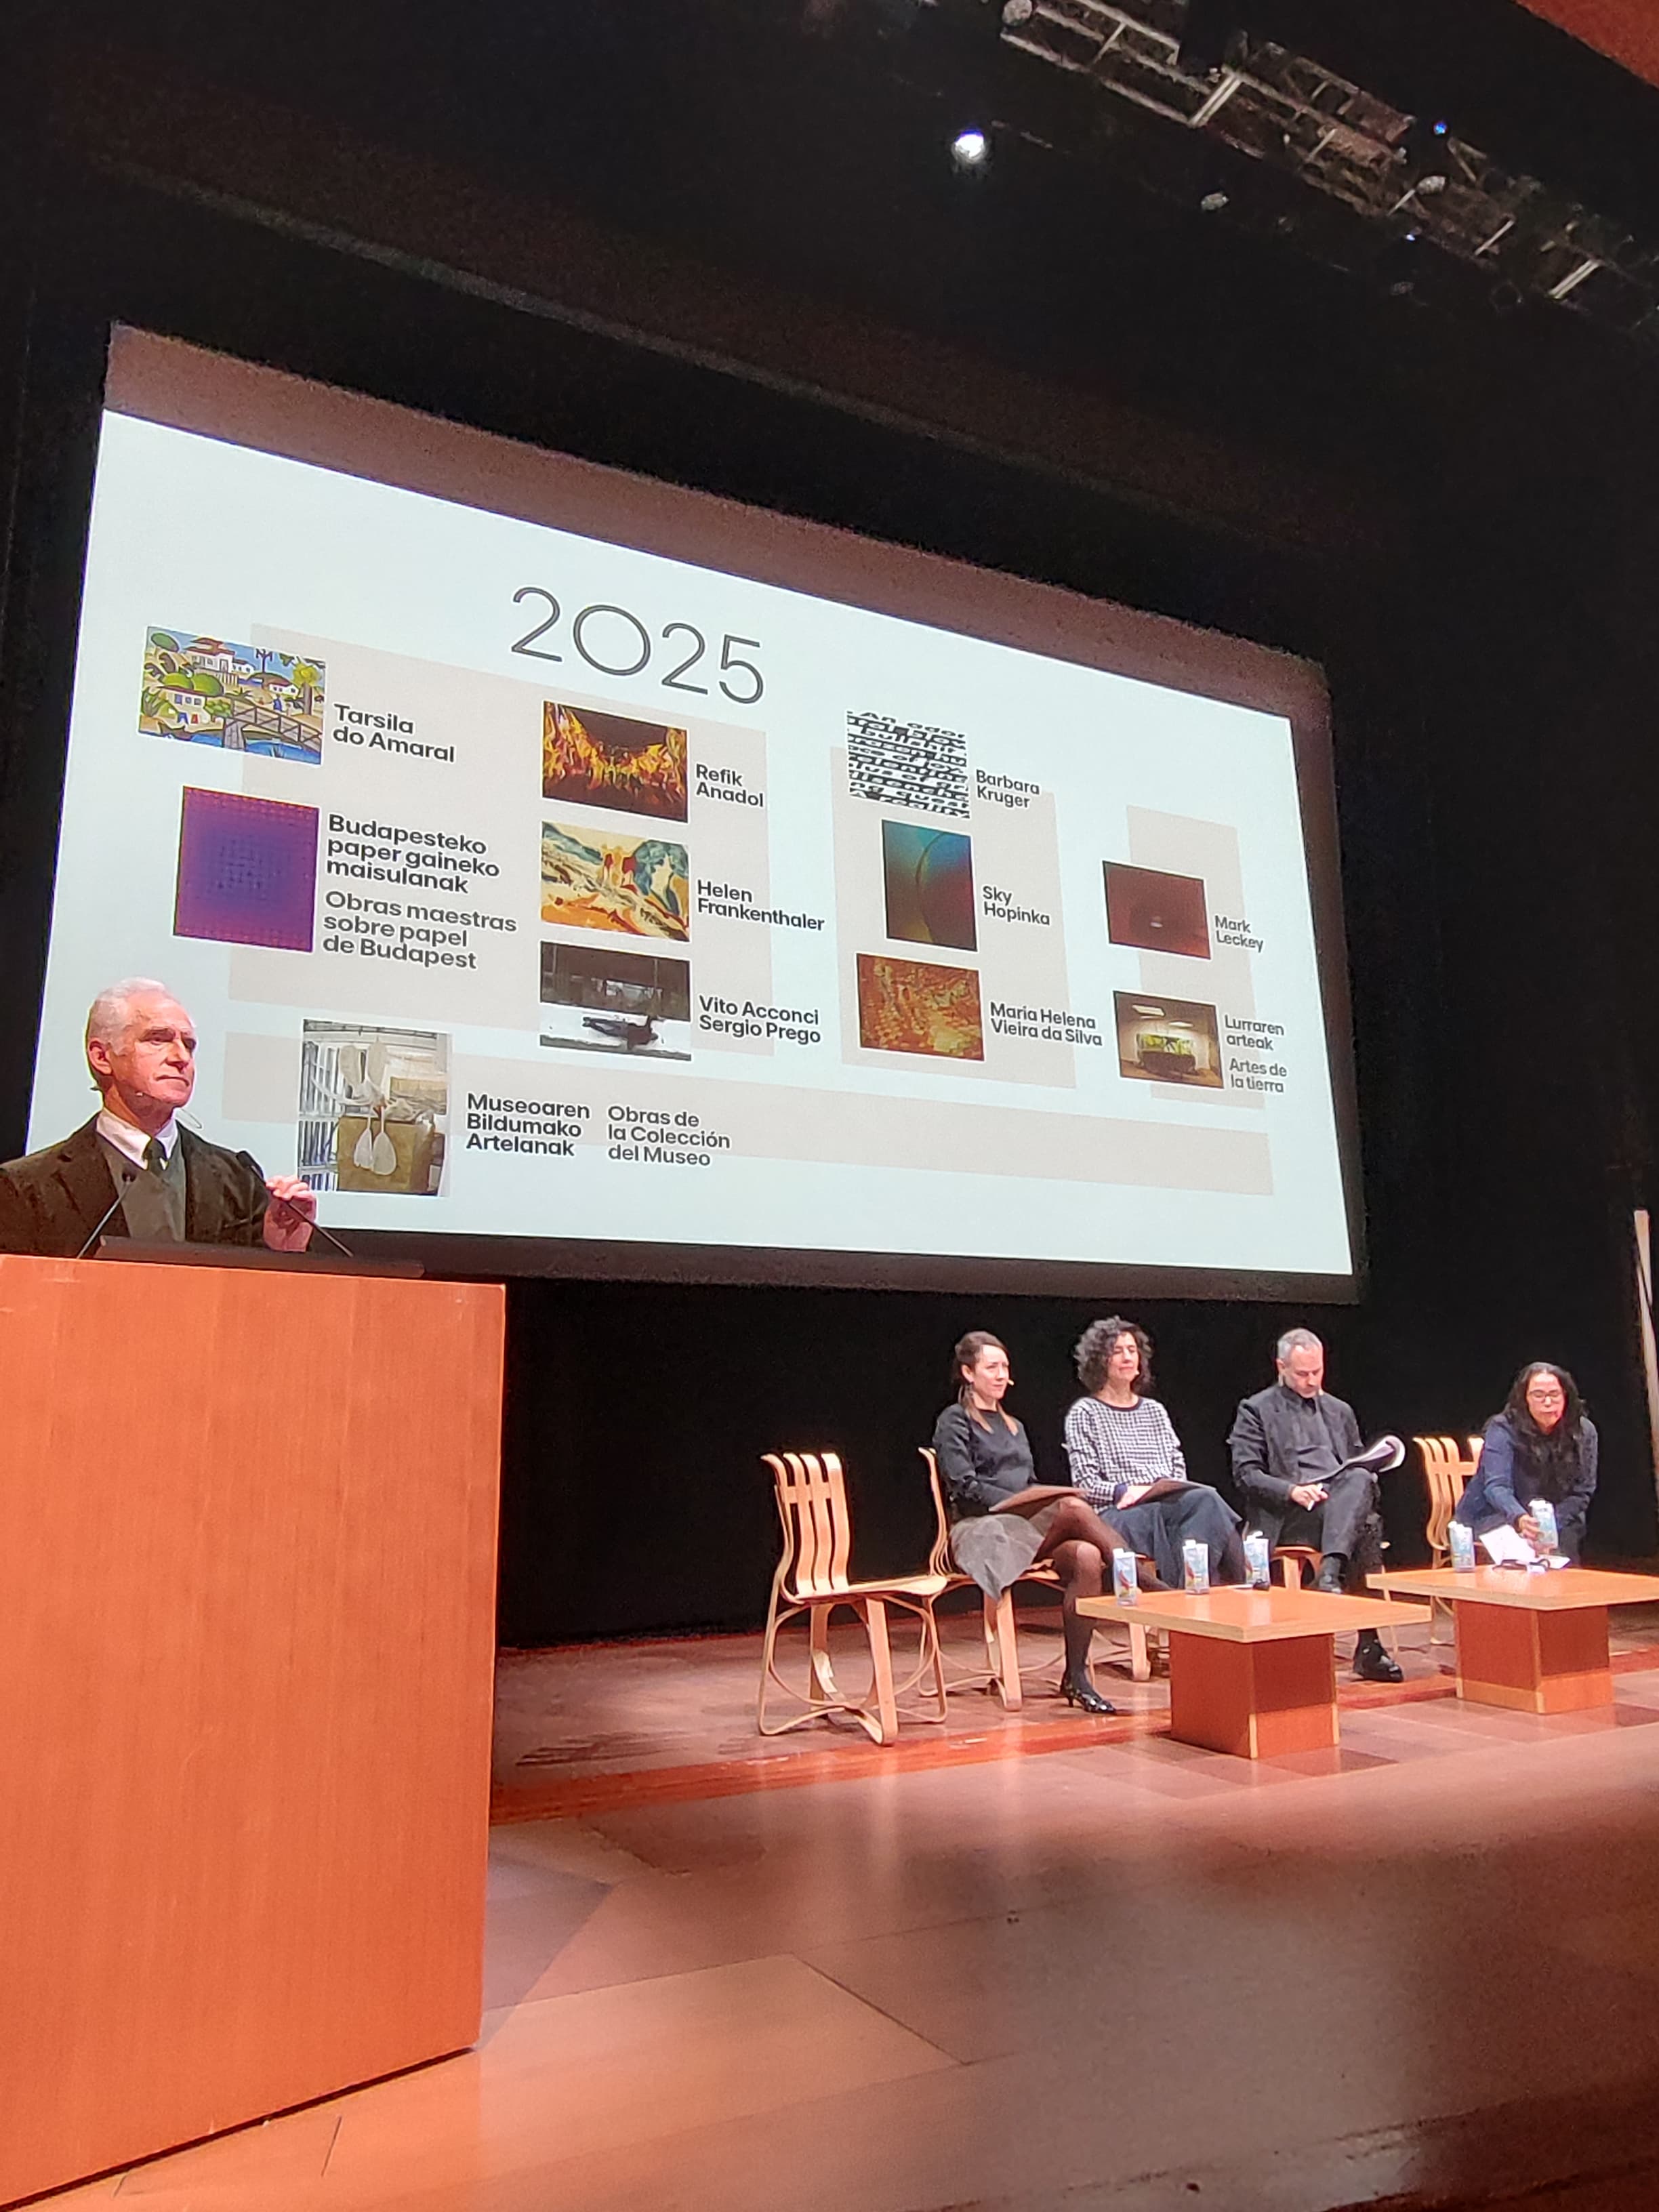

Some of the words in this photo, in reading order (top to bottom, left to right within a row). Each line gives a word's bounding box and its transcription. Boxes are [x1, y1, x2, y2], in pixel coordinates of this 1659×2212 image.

[512, 587, 763, 704] 2025
[334, 703, 413, 734] Tarsila
[333, 726, 364, 745] do
[369, 732, 454, 762] Amaral
[697, 764, 742, 787] Refik
[977, 769, 1040, 794] Barbara
[696, 782, 763, 807] Anadol
[977, 785, 1029, 808] Kruger
[329, 814, 486, 854] Budapesteko
[328, 839, 402, 862] paper
[405, 852, 499, 876] gaineko
[327, 860, 468, 893] maisulanak
[698, 880, 752, 903] Helen
[983, 886, 1012, 906] Sky
[326, 891, 401, 916] Obras
[407, 905, 516, 931] maestras
[698, 897, 825, 930] Frankenthaler
[984, 901, 1050, 925] Hopinka
[324, 916, 394, 937] sobre
[400, 926, 466, 947] papel
[1215, 916, 1250, 933] Mark
[323, 935, 354, 954] de
[361, 938, 476, 969] Budapest
[1216, 930, 1263, 952] Leckey
[699, 995, 738, 1015] Vito
[742, 1002, 818, 1025] Acconci
[991, 1002, 1038, 1021] Maria
[1040, 1009, 1096, 1029] Helena
[699, 1015, 762, 1038] Sergio
[766, 1022, 821, 1045] Prego
[991, 1018, 1038, 1038] Vieira
[1042, 1026, 1062, 1041] da
[1065, 1029, 1102, 1046] Silva
[1225, 1015, 1284, 1036] Lurraren
[1227, 1035, 1273, 1050] arteak
[1229, 1058, 1267, 1074] Artes
[1269, 1063, 1286, 1077] de
[1231, 1074, 1244, 1088] la
[1246, 1077, 1284, 1092] tierra
[468, 1093, 590, 1119] Museoaren
[608, 1106, 670, 1124] Obras
[674, 1111, 699, 1127] de
[467, 1113, 581, 1137] Bildumako
[609, 1124, 626, 1141] la
[631, 1126, 730, 1148] Colección
[466, 1133, 574, 1156] Artelanak
[609, 1144, 638, 1161] del
[644, 1146, 710, 1166] Museo
